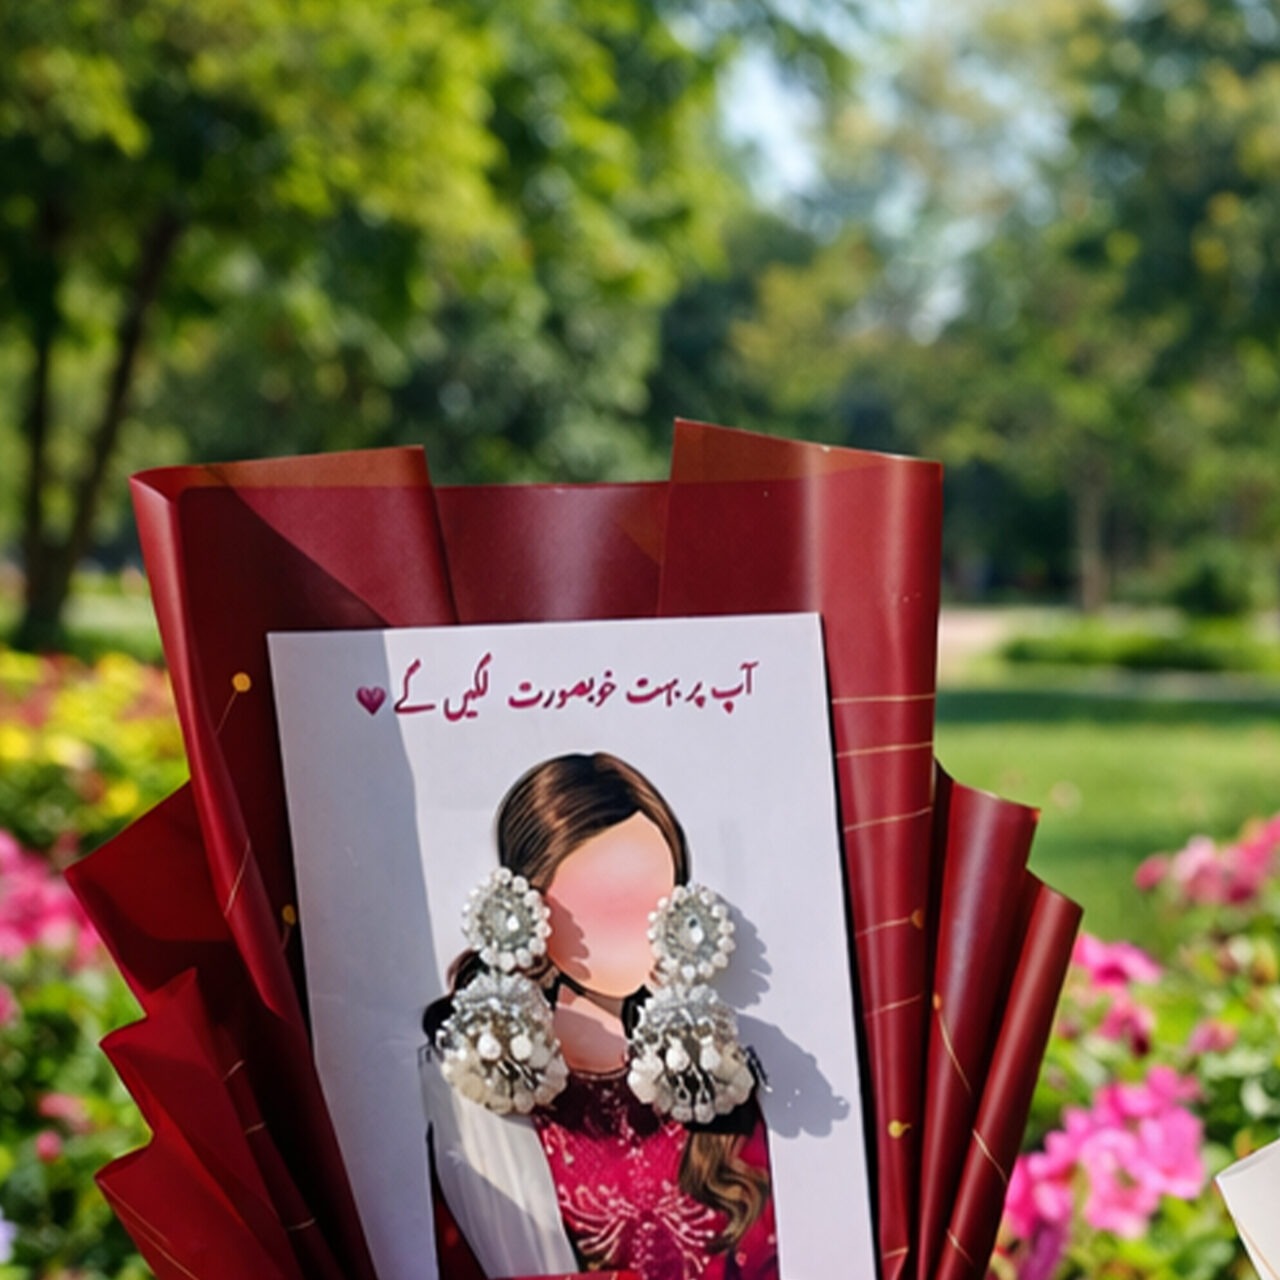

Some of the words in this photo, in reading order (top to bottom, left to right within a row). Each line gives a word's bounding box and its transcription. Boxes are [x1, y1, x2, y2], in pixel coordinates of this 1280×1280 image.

[508, 669, 617, 709] خوبصورت
[625, 677, 682, 708] بہت
[684, 681, 706, 709] پر
[711, 660, 759, 714] آپ
